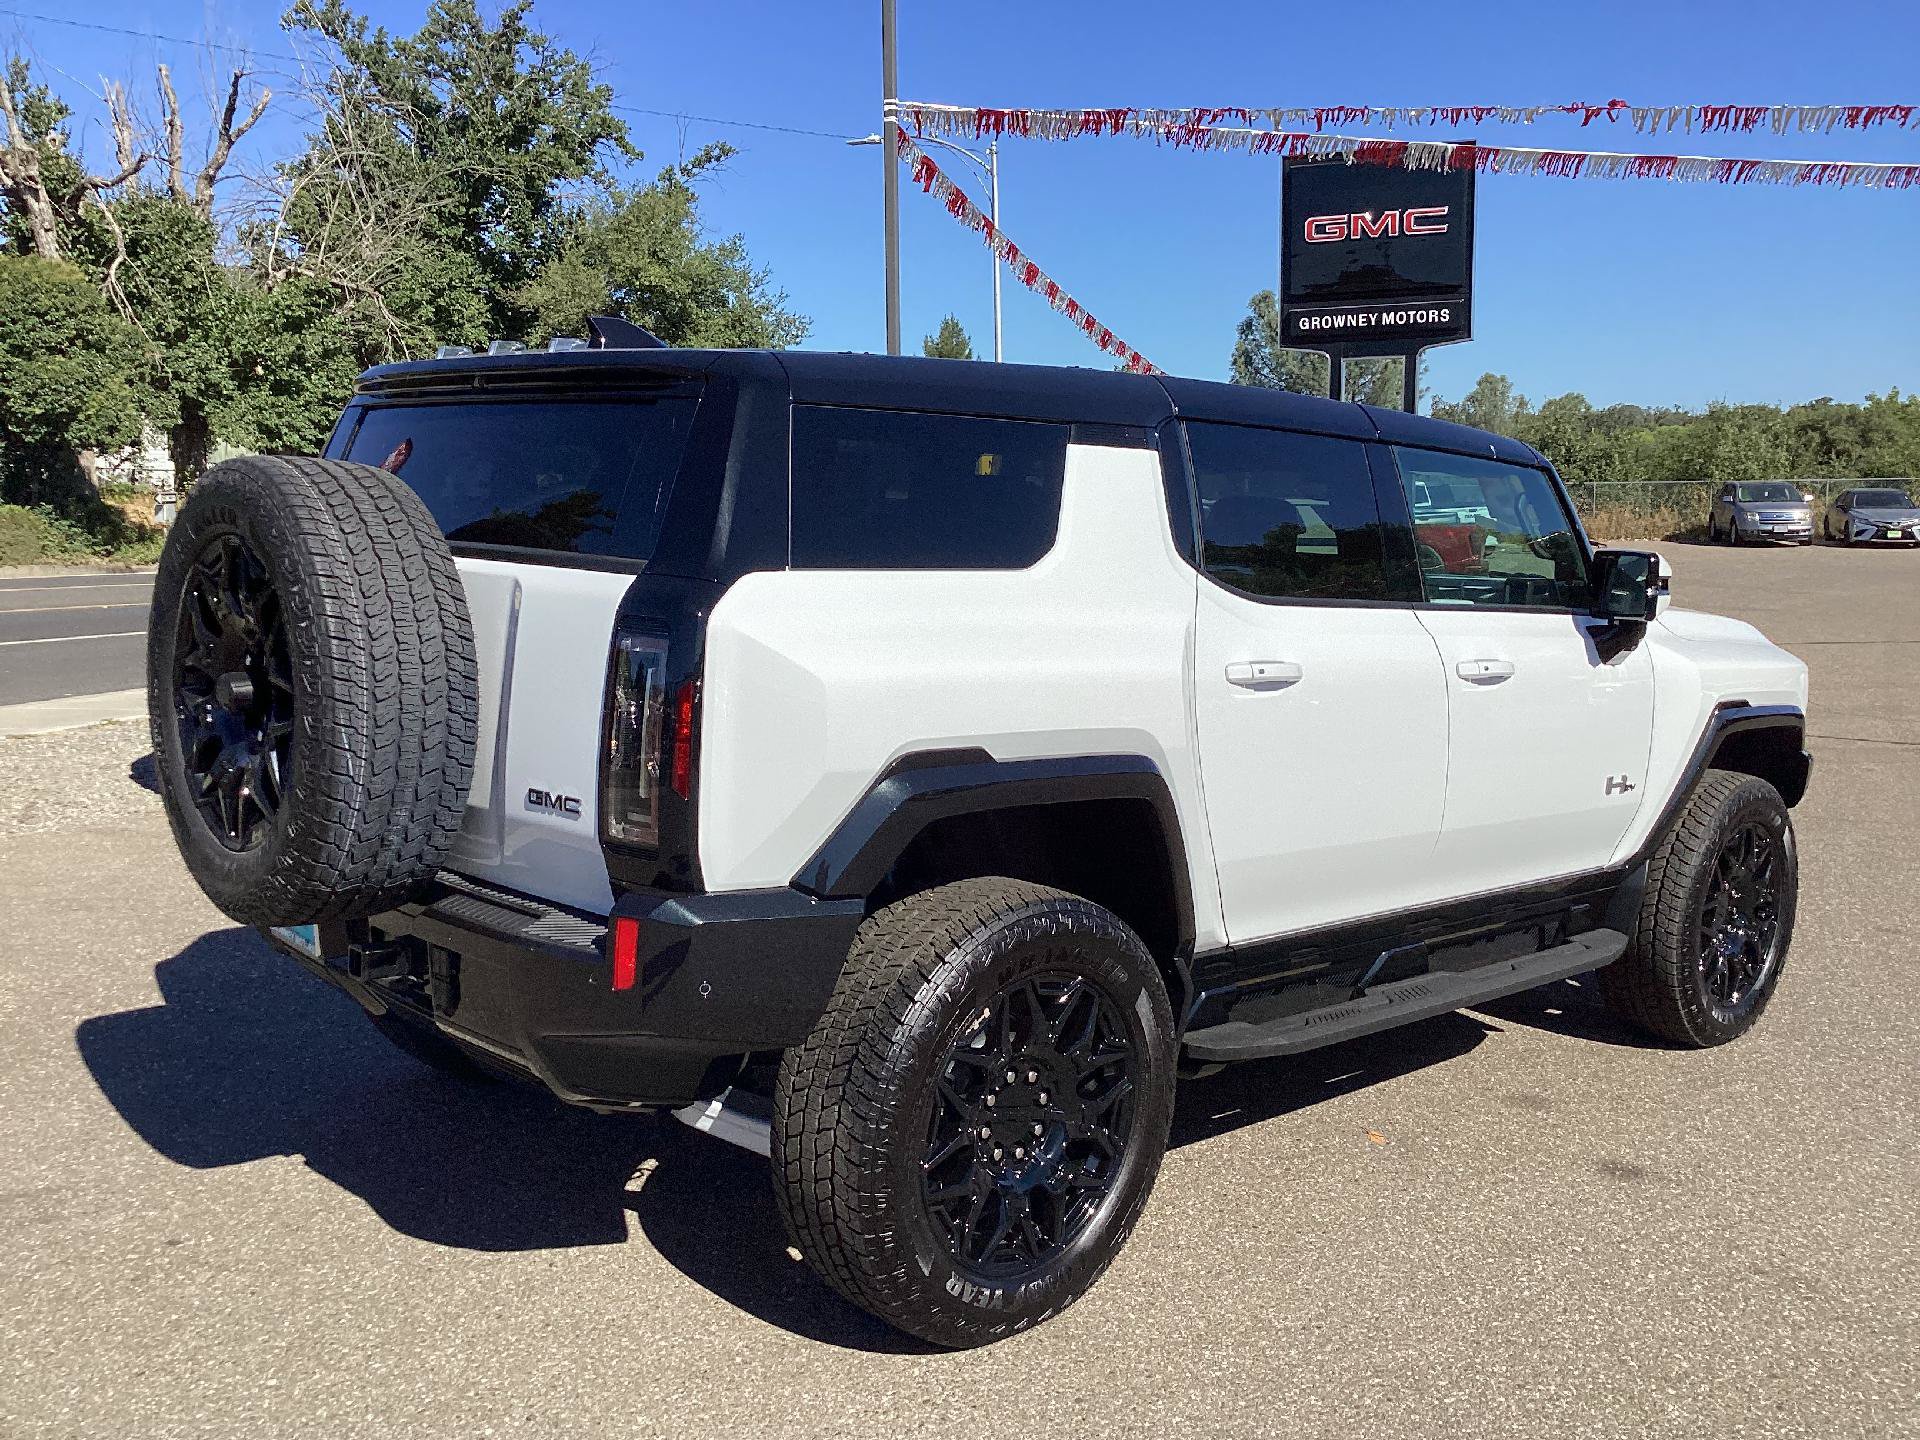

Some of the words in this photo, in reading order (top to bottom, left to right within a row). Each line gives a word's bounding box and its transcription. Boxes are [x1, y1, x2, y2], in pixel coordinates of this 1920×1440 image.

[1305, 206, 1449, 243] GMC
[1299, 313, 1378, 330] GROWNEY
[1381, 308, 1450, 325] MOTORS
[528, 787, 582, 815] GMC
